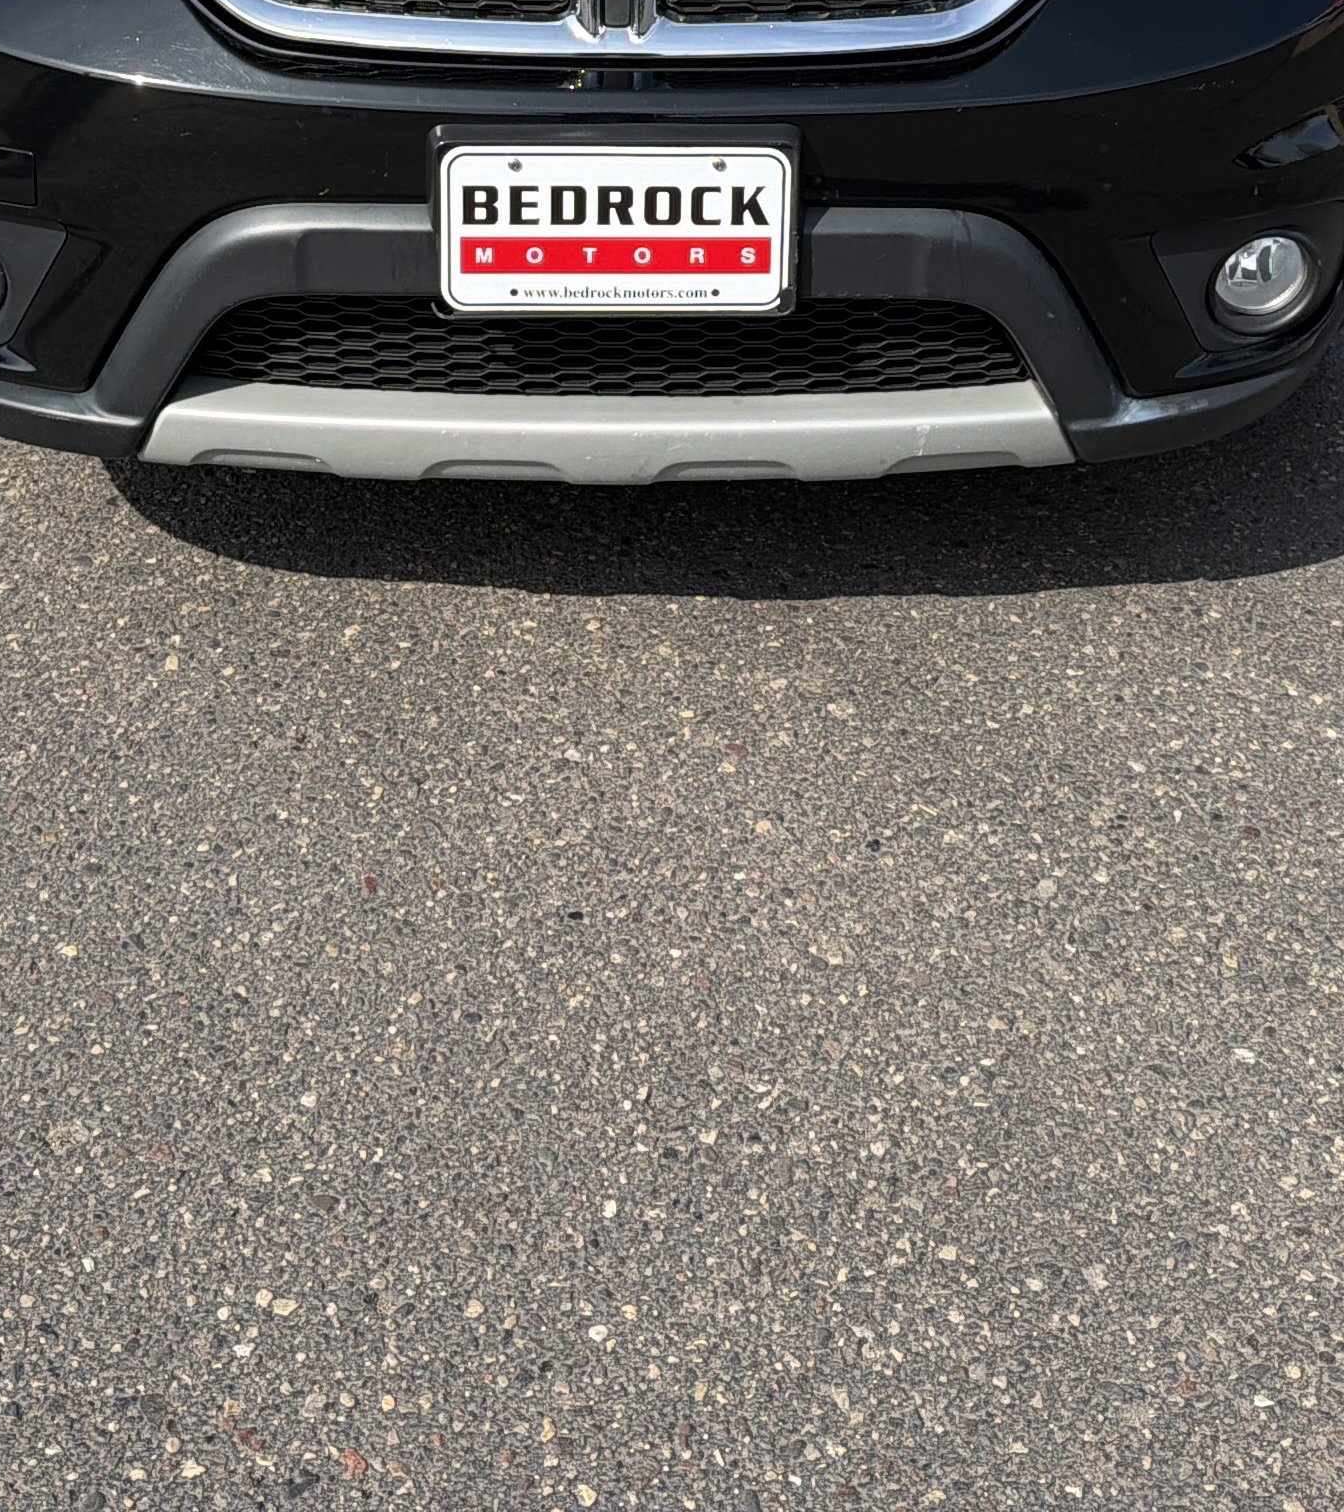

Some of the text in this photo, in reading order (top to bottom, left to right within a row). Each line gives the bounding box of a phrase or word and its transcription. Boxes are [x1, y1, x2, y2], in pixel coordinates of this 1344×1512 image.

[460, 184, 770, 227] BEDROCK
[473, 246, 758, 266] MOTORS
[523, 285, 708, 300] www.bedrockmotors.com
